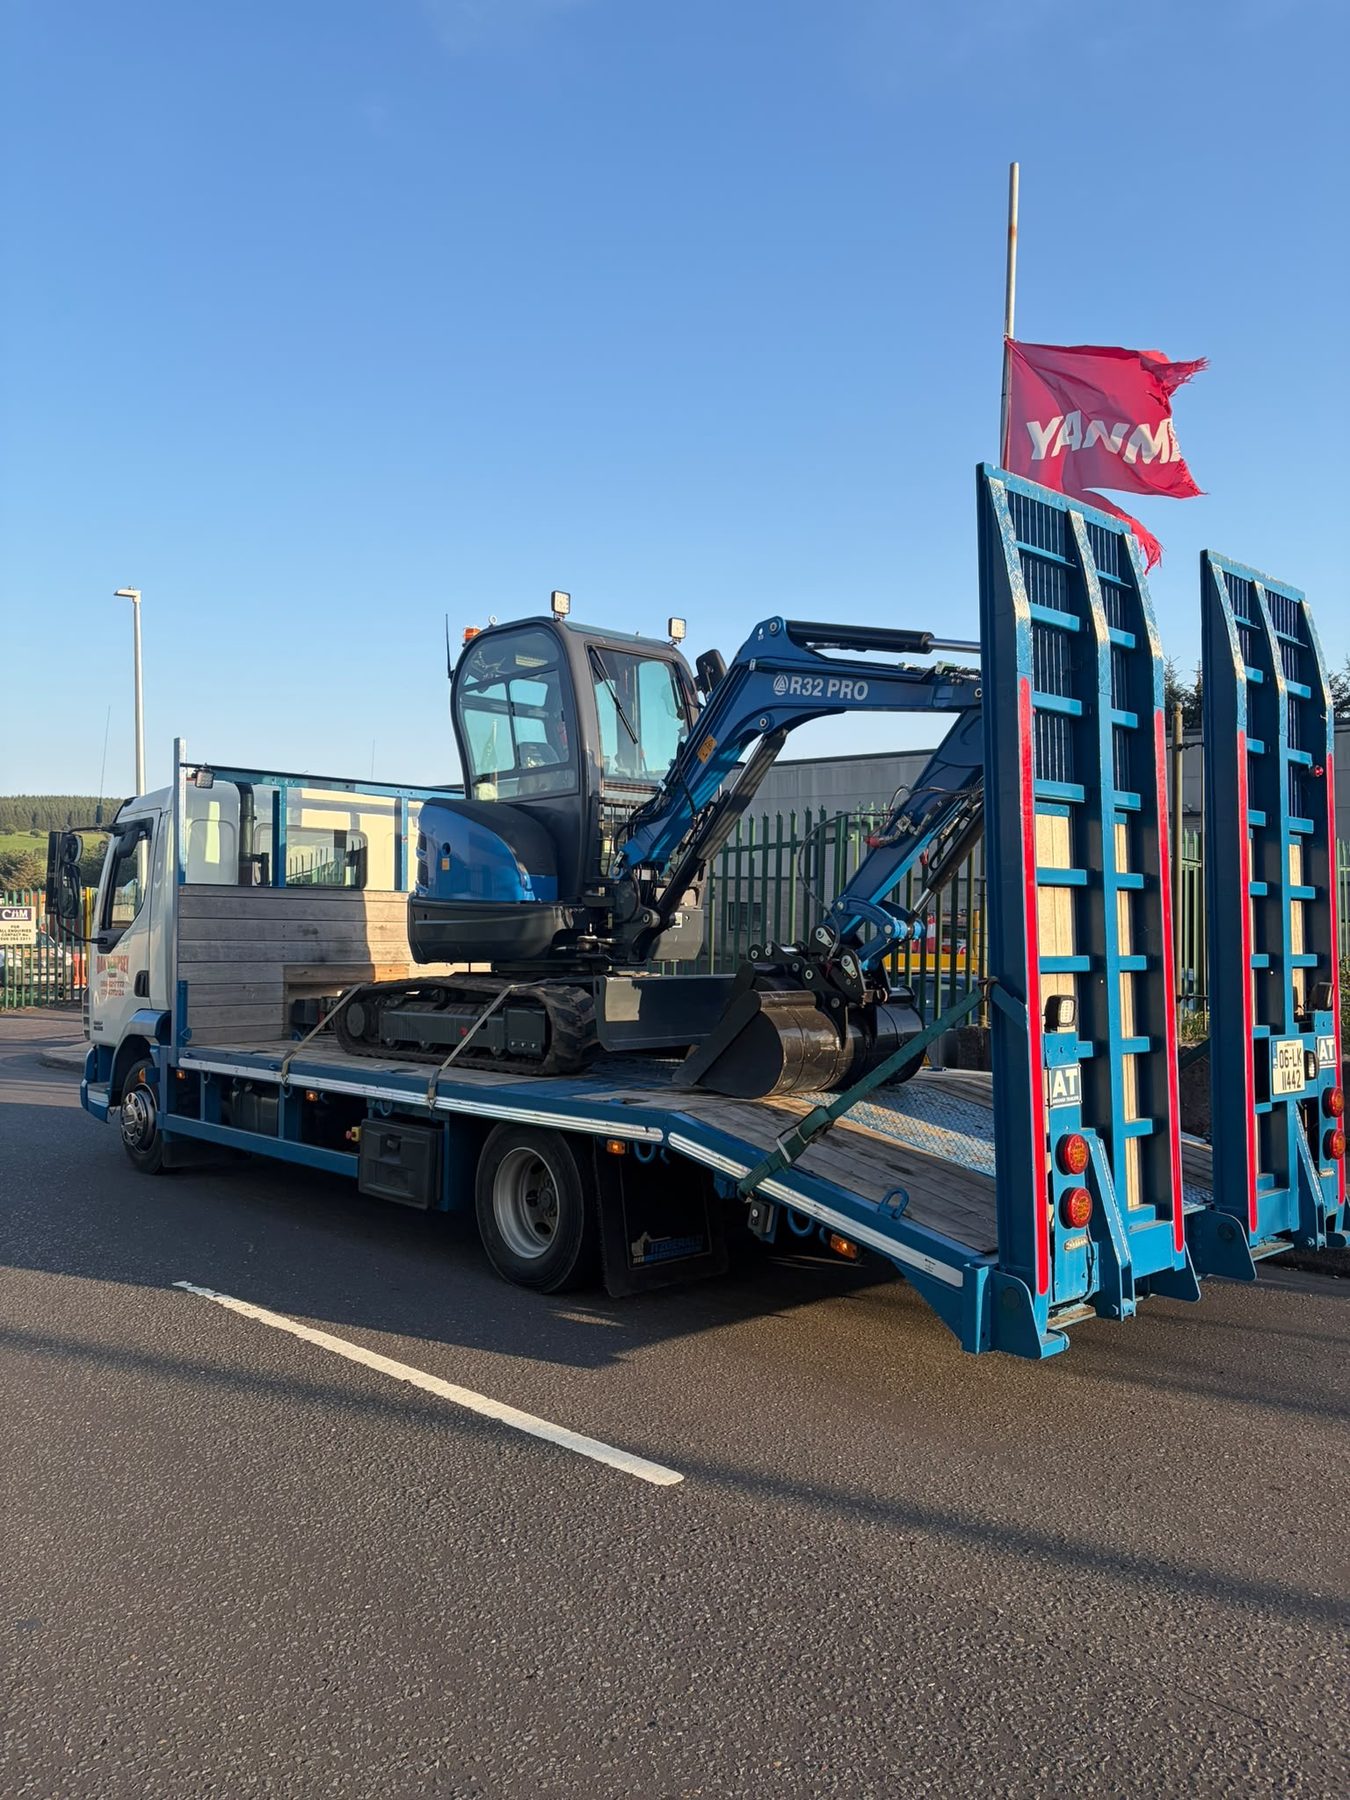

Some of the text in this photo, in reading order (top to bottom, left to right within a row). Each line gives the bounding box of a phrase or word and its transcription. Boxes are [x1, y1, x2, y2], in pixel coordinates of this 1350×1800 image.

[789, 676, 869, 701] R32 PRO
[1279, 1048, 1302, 1069] 06-LK
[1319, 1039, 1336, 1061] AT
[1052, 1068, 1078, 1098] AT
